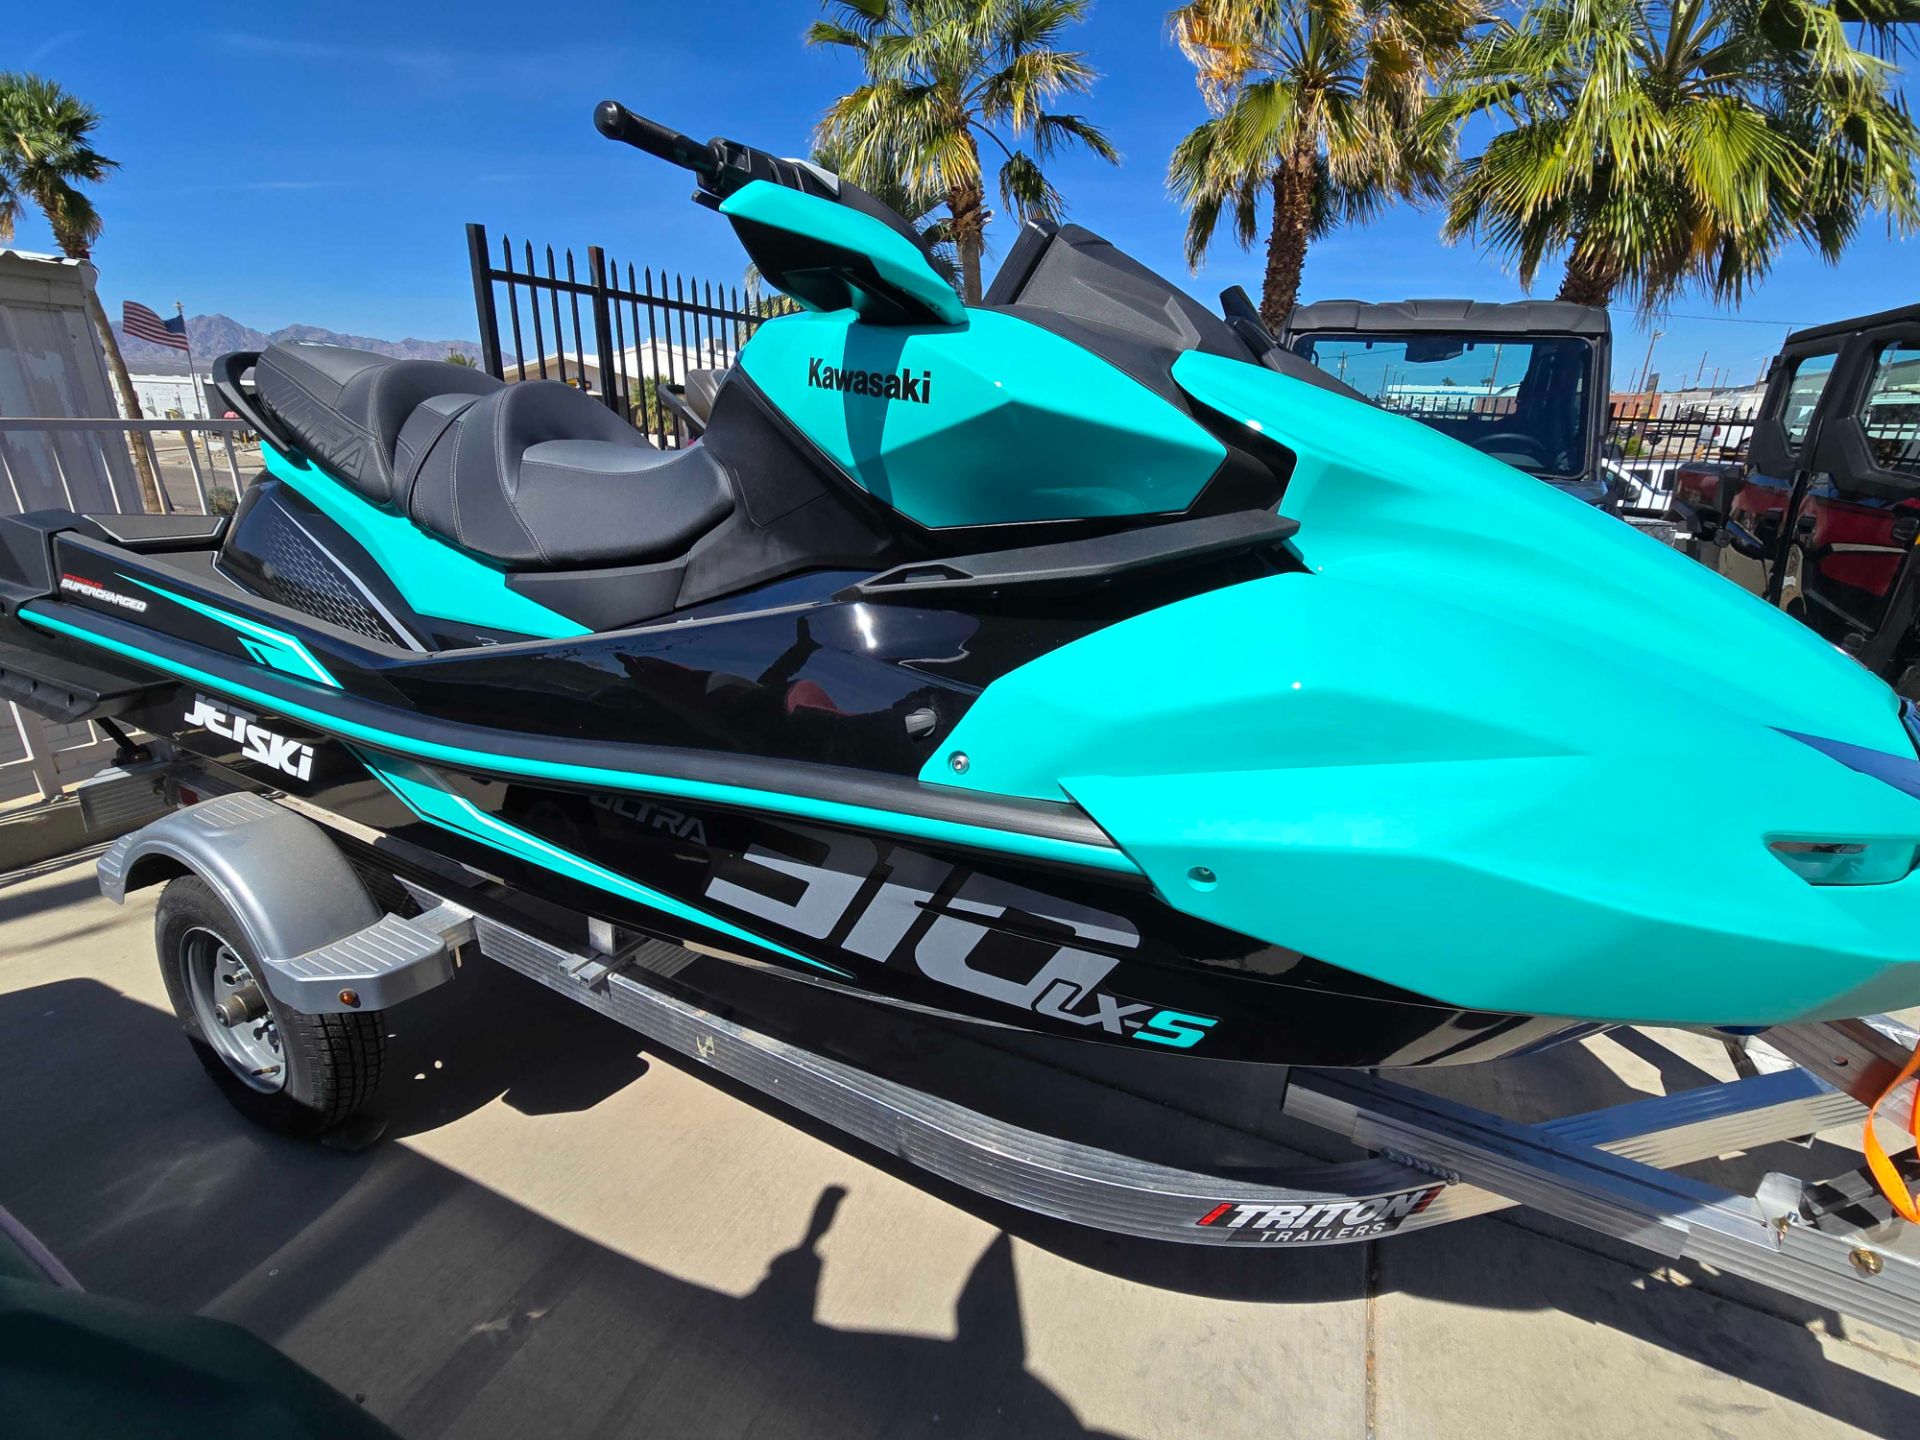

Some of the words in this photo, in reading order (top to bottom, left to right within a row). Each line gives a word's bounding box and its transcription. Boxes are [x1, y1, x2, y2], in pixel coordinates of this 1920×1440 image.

[808, 357, 931, 404] Kawasaki
[60, 578, 147, 613] SUPERCHARGED
[1227, 1190, 1428, 1229] TRITON
[1260, 1222, 1386, 1242] TRAILERS
